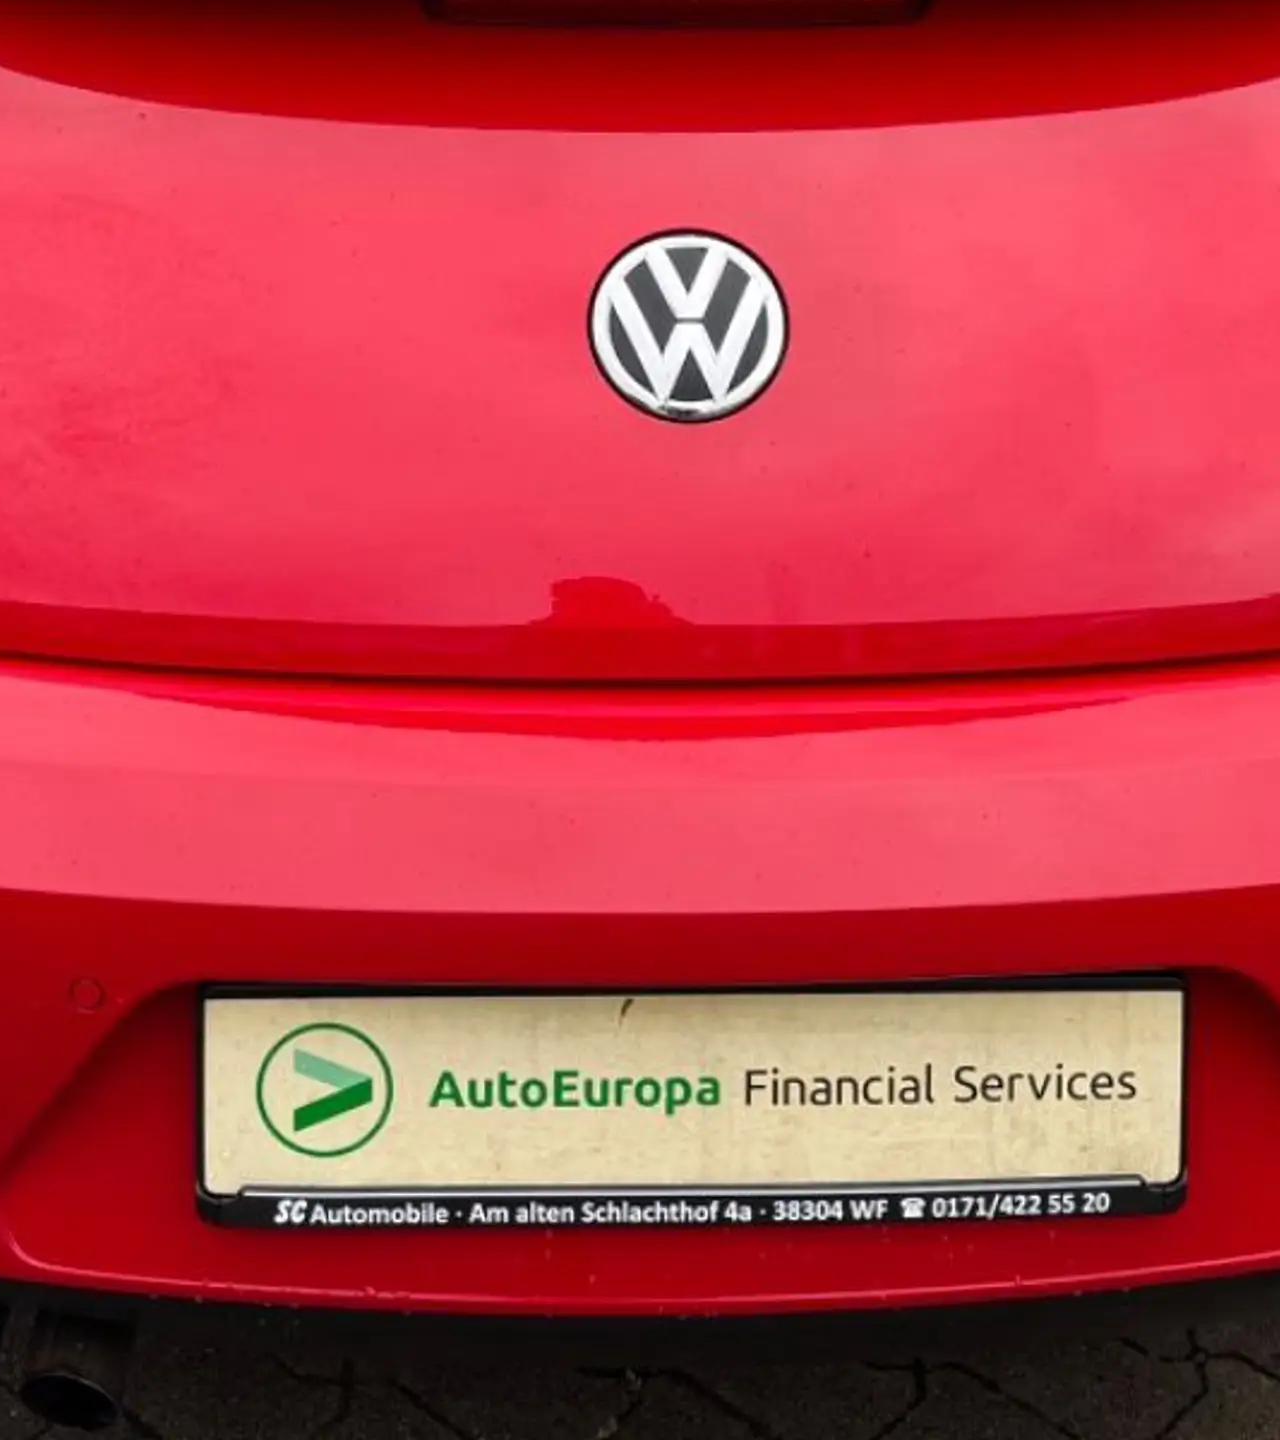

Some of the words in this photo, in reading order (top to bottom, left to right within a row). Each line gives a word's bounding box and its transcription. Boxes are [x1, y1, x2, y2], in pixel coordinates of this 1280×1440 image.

[593, 234, 782, 415] VW
[428, 1069, 721, 1116] AutoEuropa
[744, 1063, 934, 1106] Financial
[953, 1063, 1138, 1103] Services
[273, 1199, 309, 1224] SC
[309, 1202, 450, 1225] Automobile
[470, 1202, 510, 1224] Am
[515, 1201, 575, 1224] alten
[581, 1200, 720, 1223] Schlachthof
[723, 1200, 753, 1222] 4a
[773, 1199, 844, 1221] 38304
[849, 1199, 889, 1220] WF
[932, 1194, 1042, 1220] 0171/422
[1048, 1194, 1076, 1214] 55
[1082, 1192, 1110, 1213] 20
